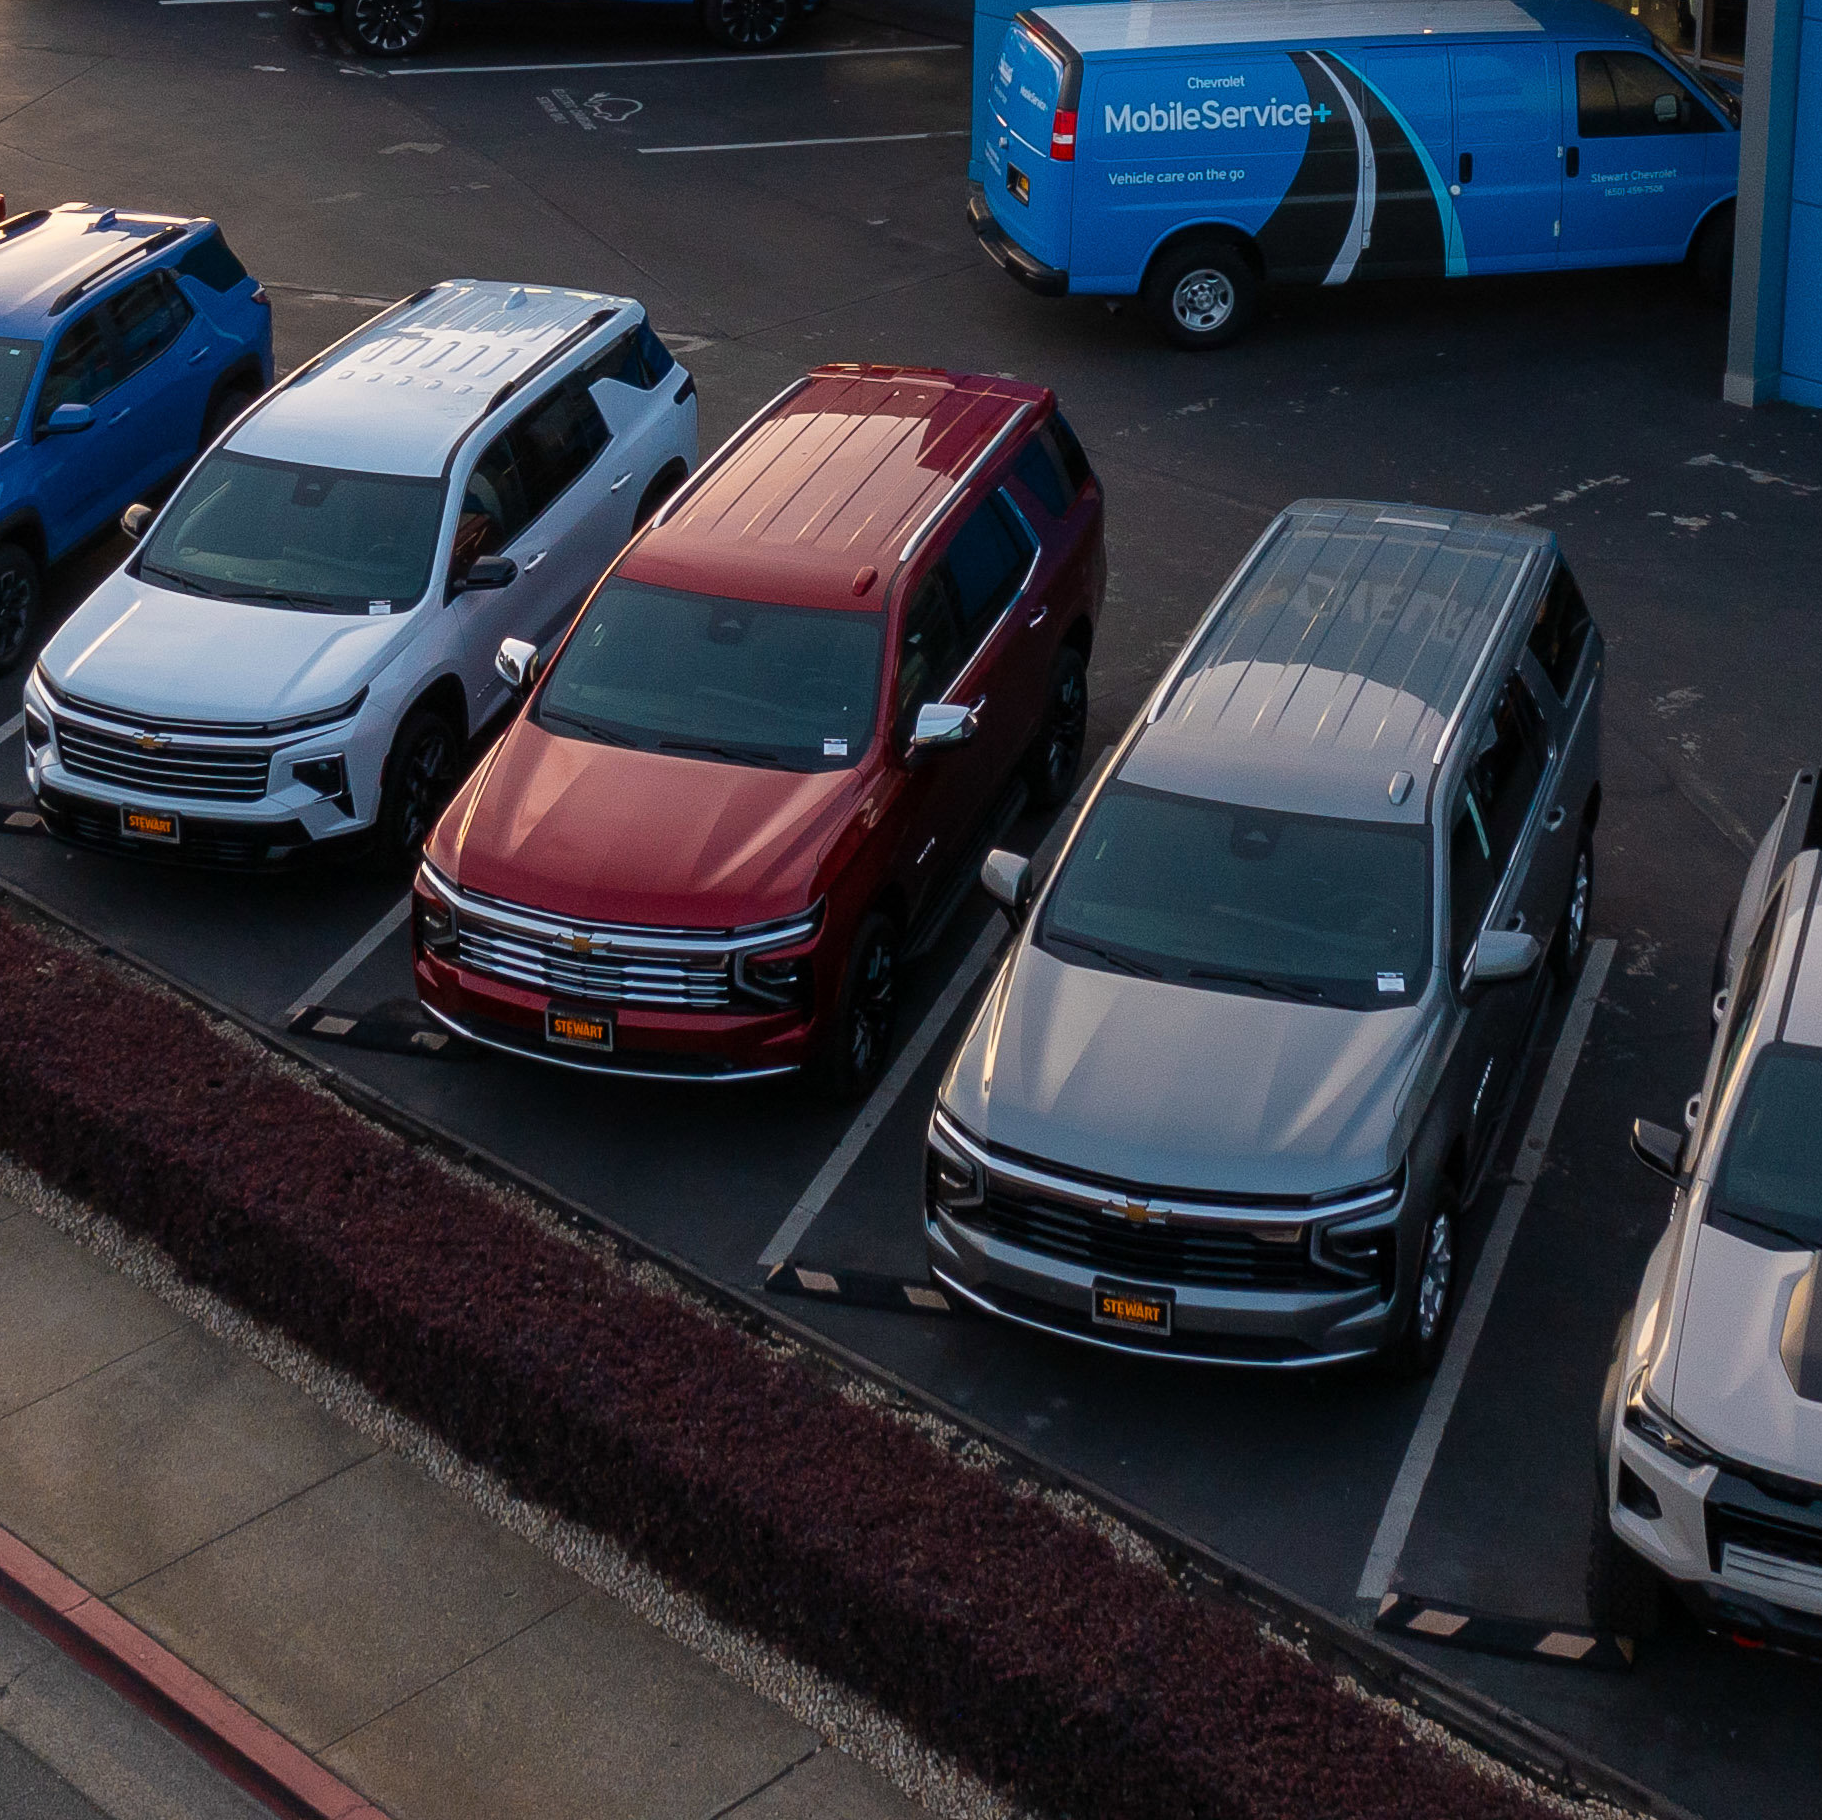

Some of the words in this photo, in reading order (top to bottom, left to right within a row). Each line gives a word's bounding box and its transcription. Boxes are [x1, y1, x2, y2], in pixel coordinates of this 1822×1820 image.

[1187, 75, 1245, 90] Chevrolet
[1108, 171, 1154, 186] Vehicle
[1157, 171, 1185, 183] care
[1187, 170, 1204, 182] on
[1206, 168, 1227, 181] the
[1229, 168, 1245, 182] go
[1591, 172, 1629, 183] Stewart
[1630, 167, 1677, 181] Chevrolet
[129, 815, 172, 834] STEWART
[554, 1018, 603, 1040] STEWART
[1102, 1297, 1161, 1322] STEWART
